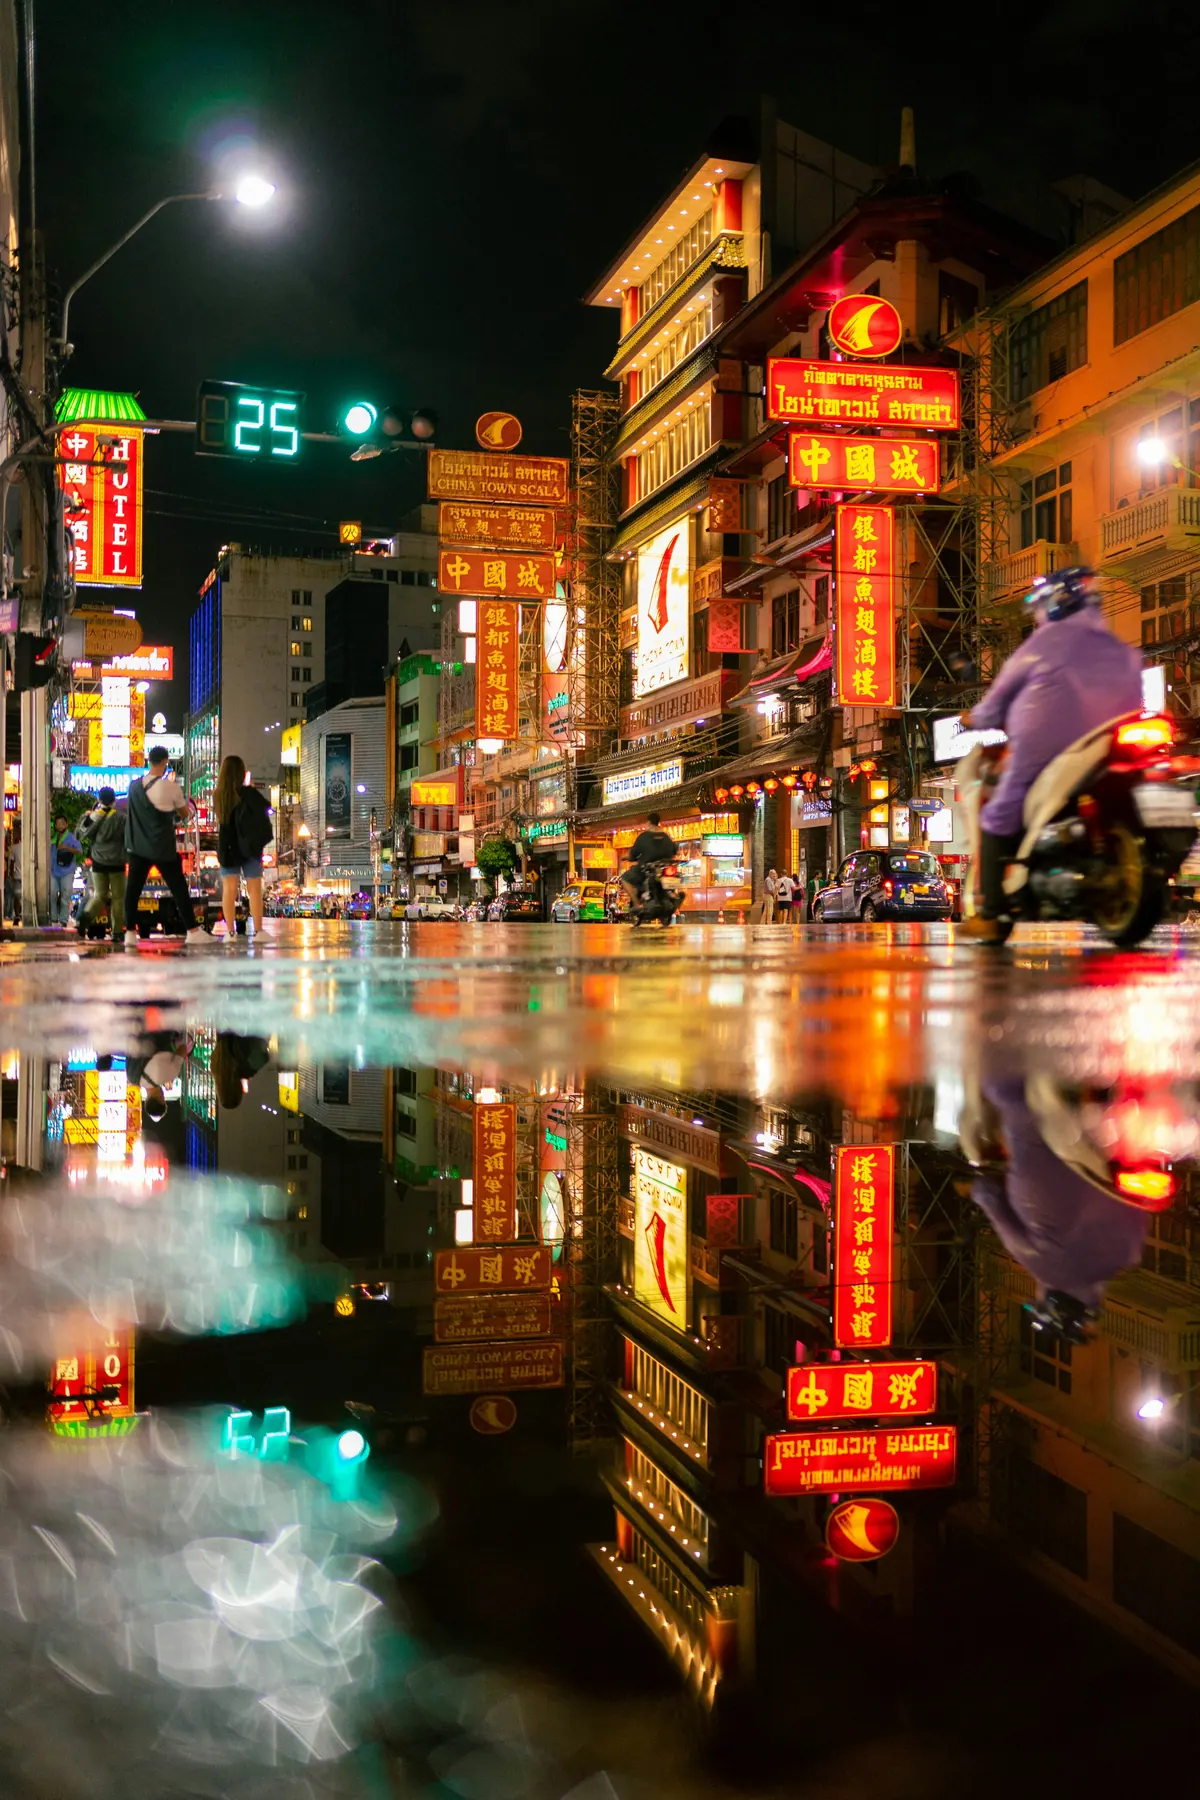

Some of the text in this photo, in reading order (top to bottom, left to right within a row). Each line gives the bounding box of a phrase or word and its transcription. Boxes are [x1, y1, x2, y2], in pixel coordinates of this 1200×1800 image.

[775, 384, 951, 422] ไชน่าทาวน์ สกาล่า
[235, 398, 298, 456] 25
[800, 438, 926, 487] 中國城
[437, 478, 560, 498] CHINA TOWN SCALA
[446, 555, 544, 594] 中國城
[852, 515, 879, 698] 銀都魚翅酒樓
[483, 608, 511, 734] 銀都魚翅酒樓
[641, 663, 686, 692] SCALA
[934, 800, 940, 808] 2
